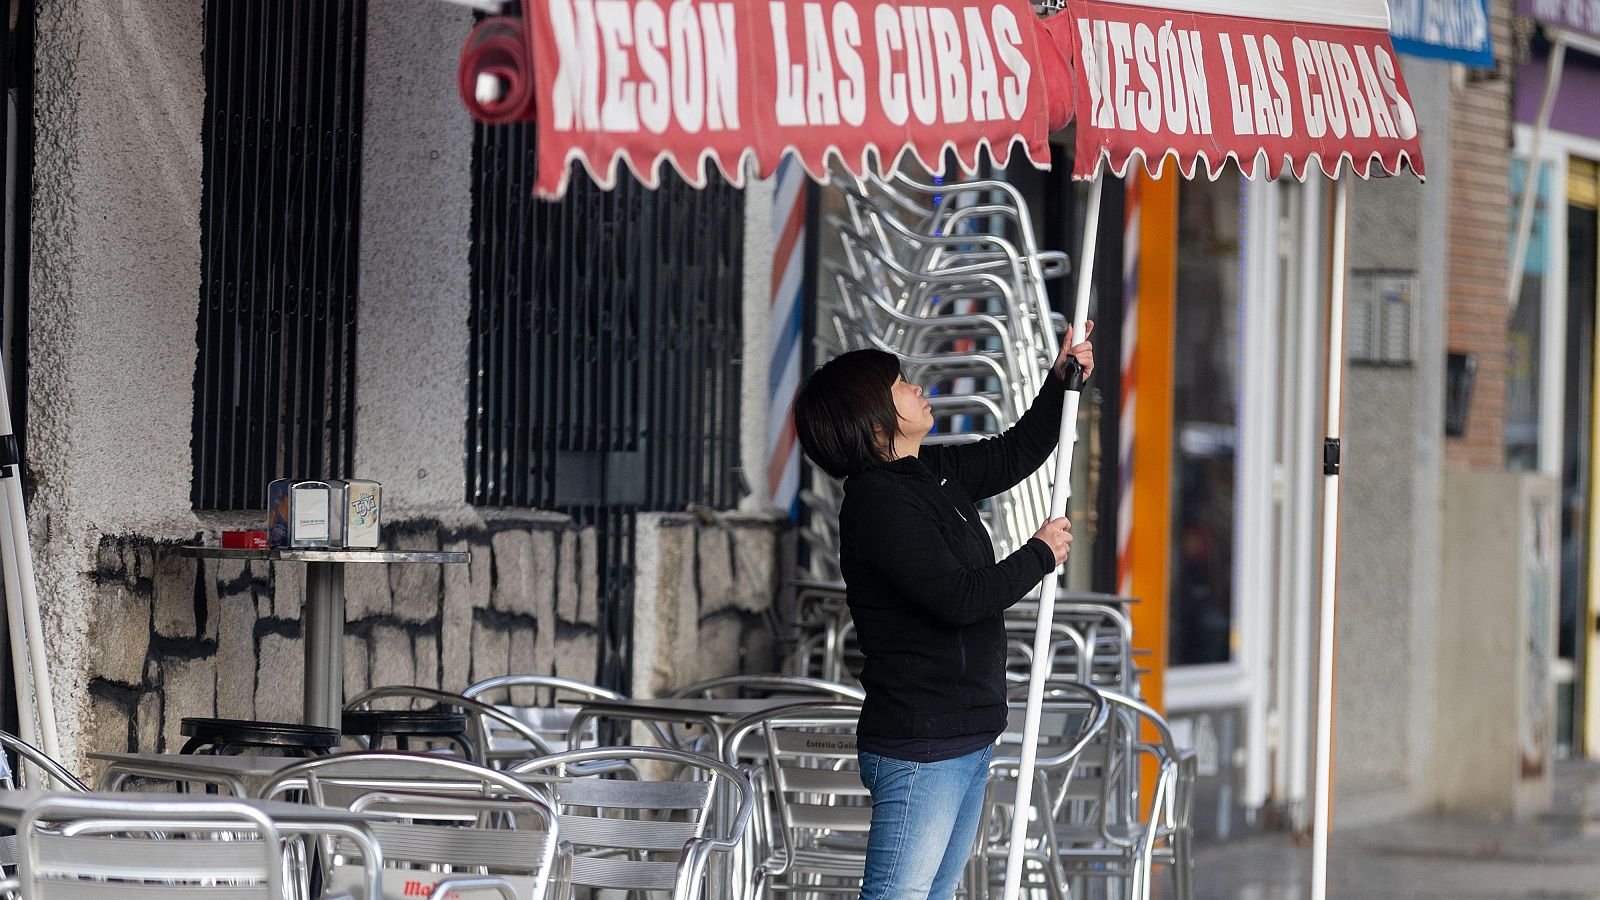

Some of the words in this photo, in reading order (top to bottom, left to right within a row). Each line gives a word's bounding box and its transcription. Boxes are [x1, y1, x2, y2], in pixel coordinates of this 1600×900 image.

[549, 0, 740, 134] MESÓN
[769, 0, 866, 127] LAS
[875, 4, 1030, 126] CUBAS
[1076, 18, 1212, 134] MESÓN
[1219, 33, 1292, 138] LAS
[1291, 37, 1417, 139] CUBAS
[806, 739, 836, 749] Estrella
